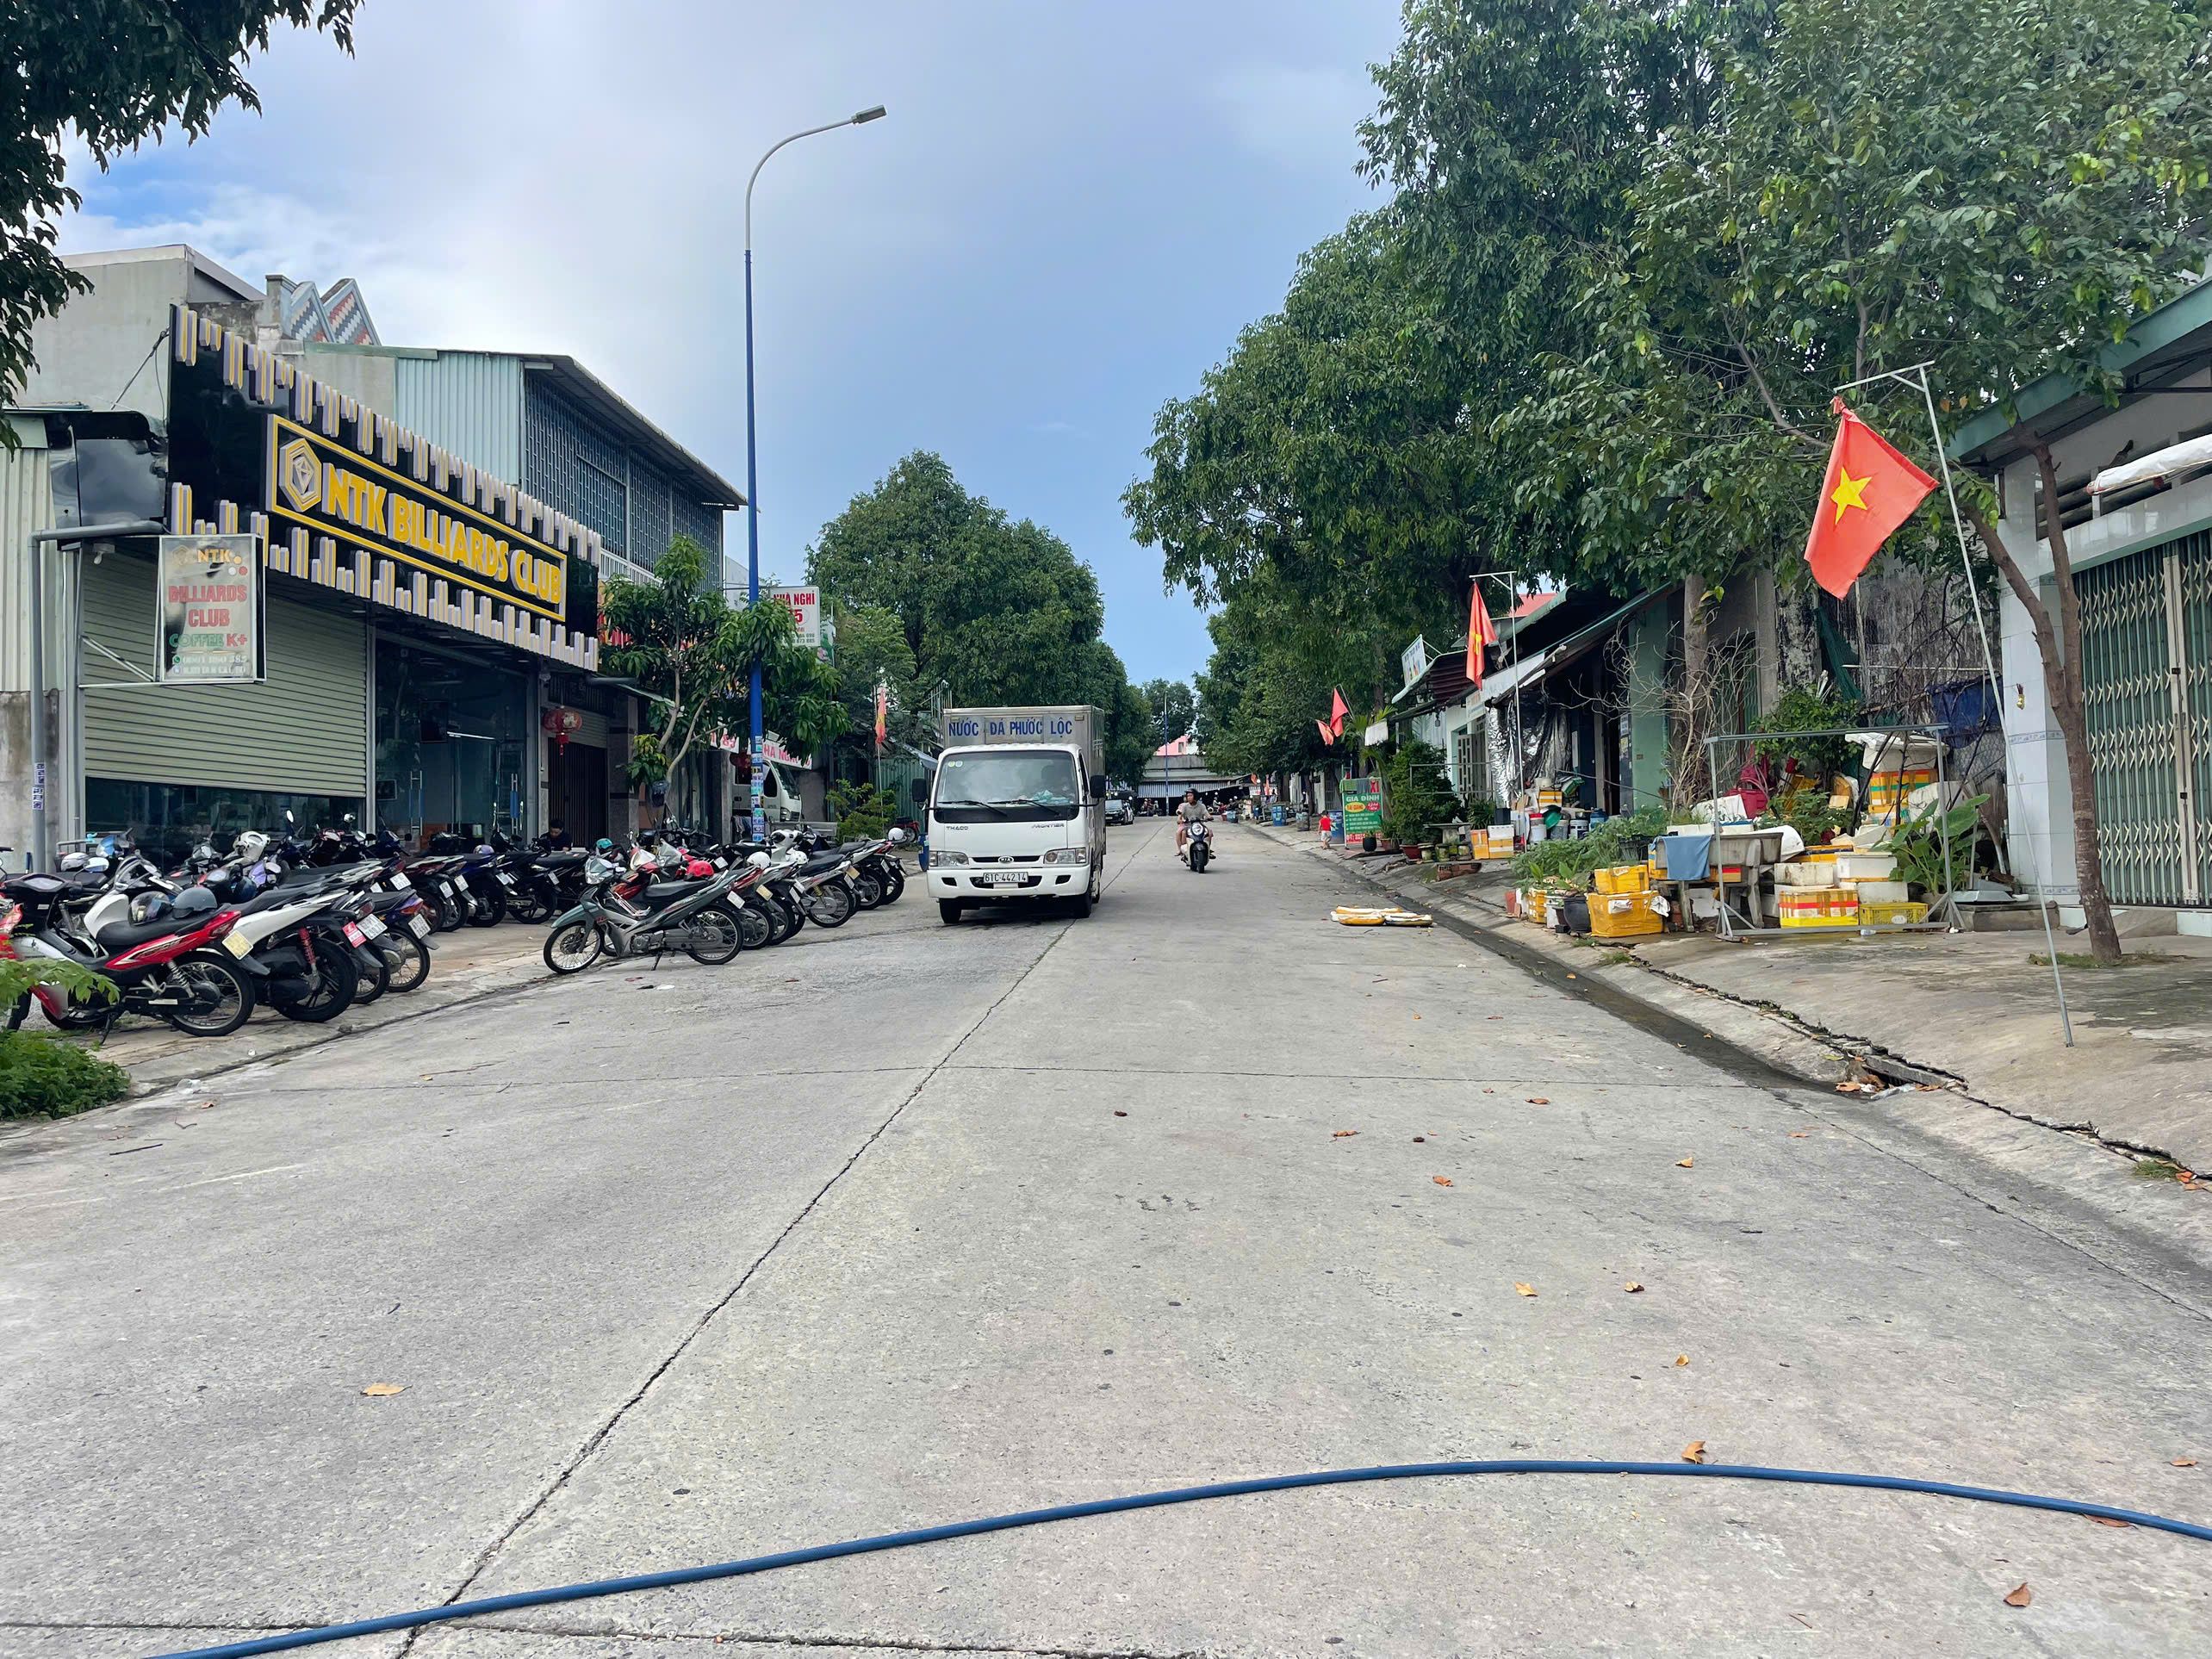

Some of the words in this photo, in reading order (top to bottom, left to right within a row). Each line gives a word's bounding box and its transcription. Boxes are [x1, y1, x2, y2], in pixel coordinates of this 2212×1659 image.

[322, 463, 388, 535] NTK
[388, 492, 509, 582] BILLIARDS
[510, 549, 561, 605] CLUB
[197, 549, 231, 563] NTK
[168, 585, 248, 603] BILLIARDS
[793, 590, 816, 606] NGHỈ
[188, 608, 230, 627] CLUB
[169, 633, 224, 647] COFFEE
[227, 633, 248, 647] K+
[948, 718, 979, 736] NƯỚC
[990, 718, 1005, 736] ĐÁ
[1010, 717, 1042, 736] PHƯỚC
[1050, 717, 1072, 738] LỘC
